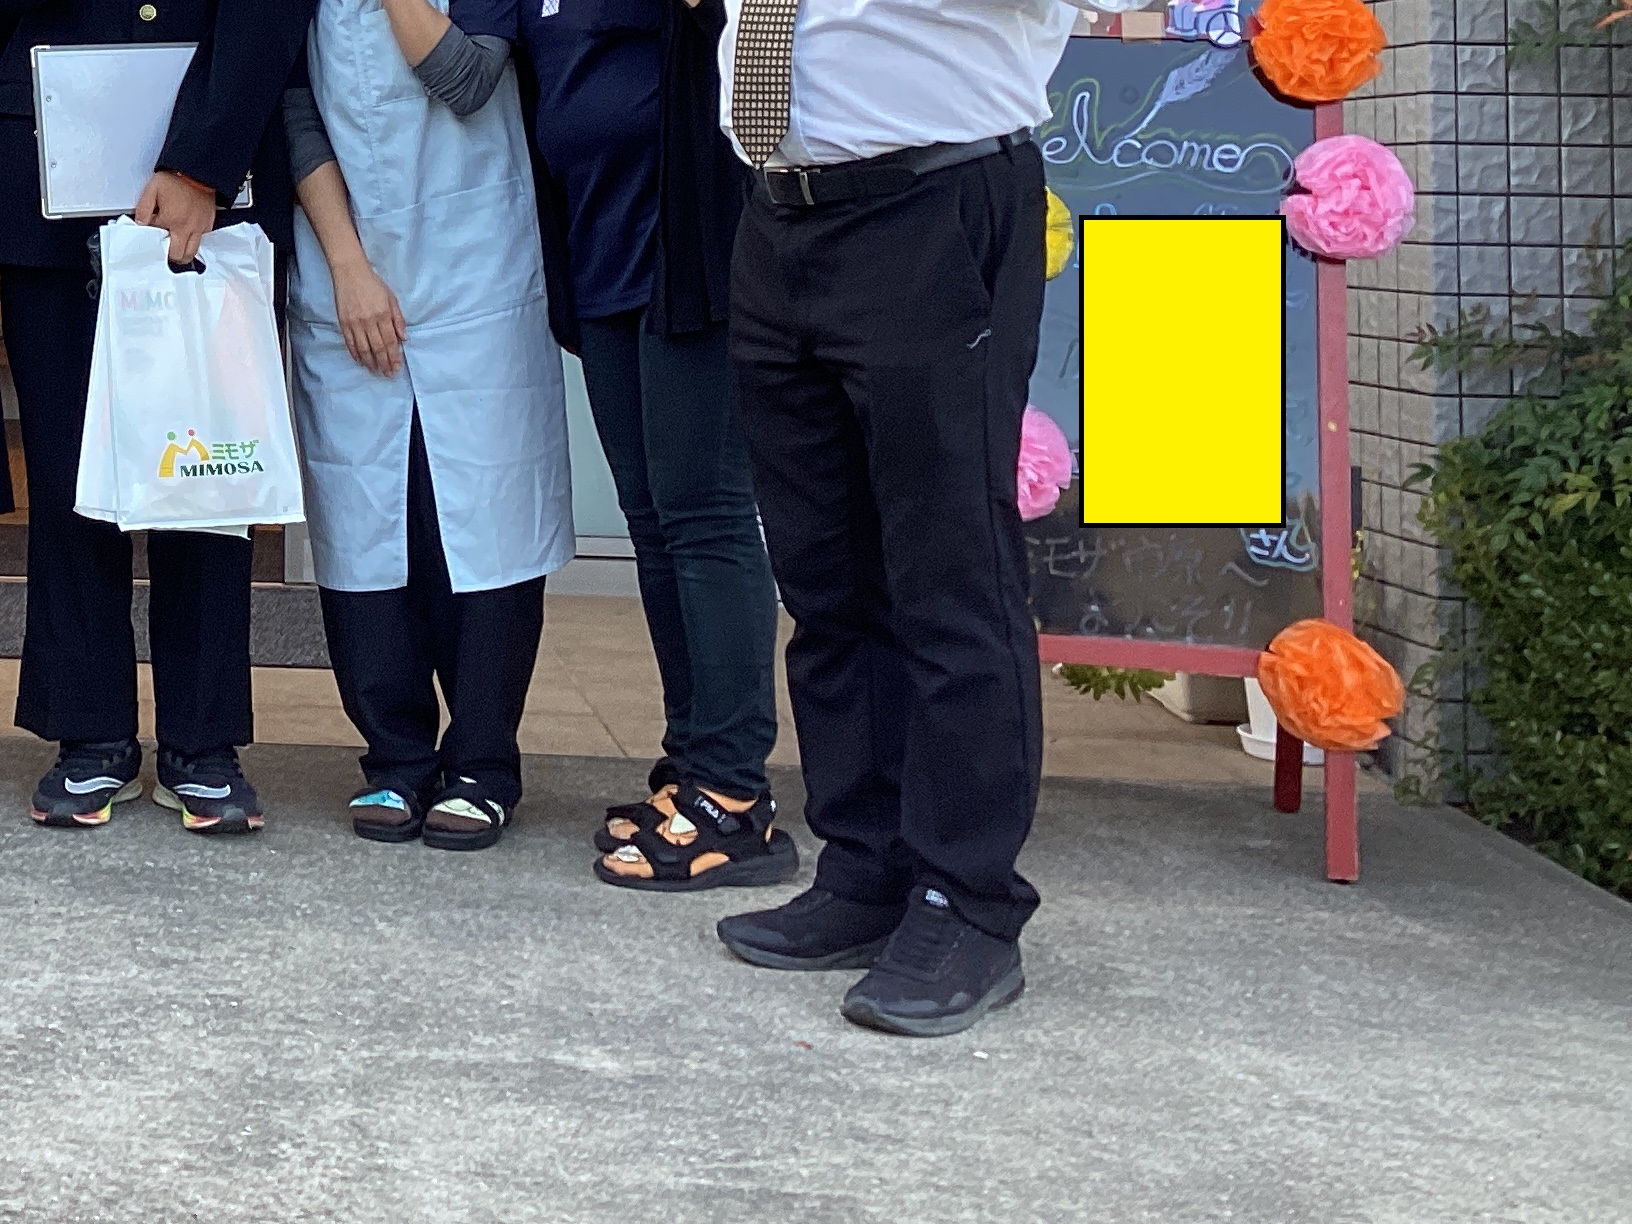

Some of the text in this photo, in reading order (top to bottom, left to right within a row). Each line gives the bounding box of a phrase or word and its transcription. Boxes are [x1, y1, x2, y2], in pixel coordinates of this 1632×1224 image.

[1041, 90, 1294, 176] elcome
[211, 439, 260, 460] ミモザ
[180, 460, 264, 477] MIMOSA
